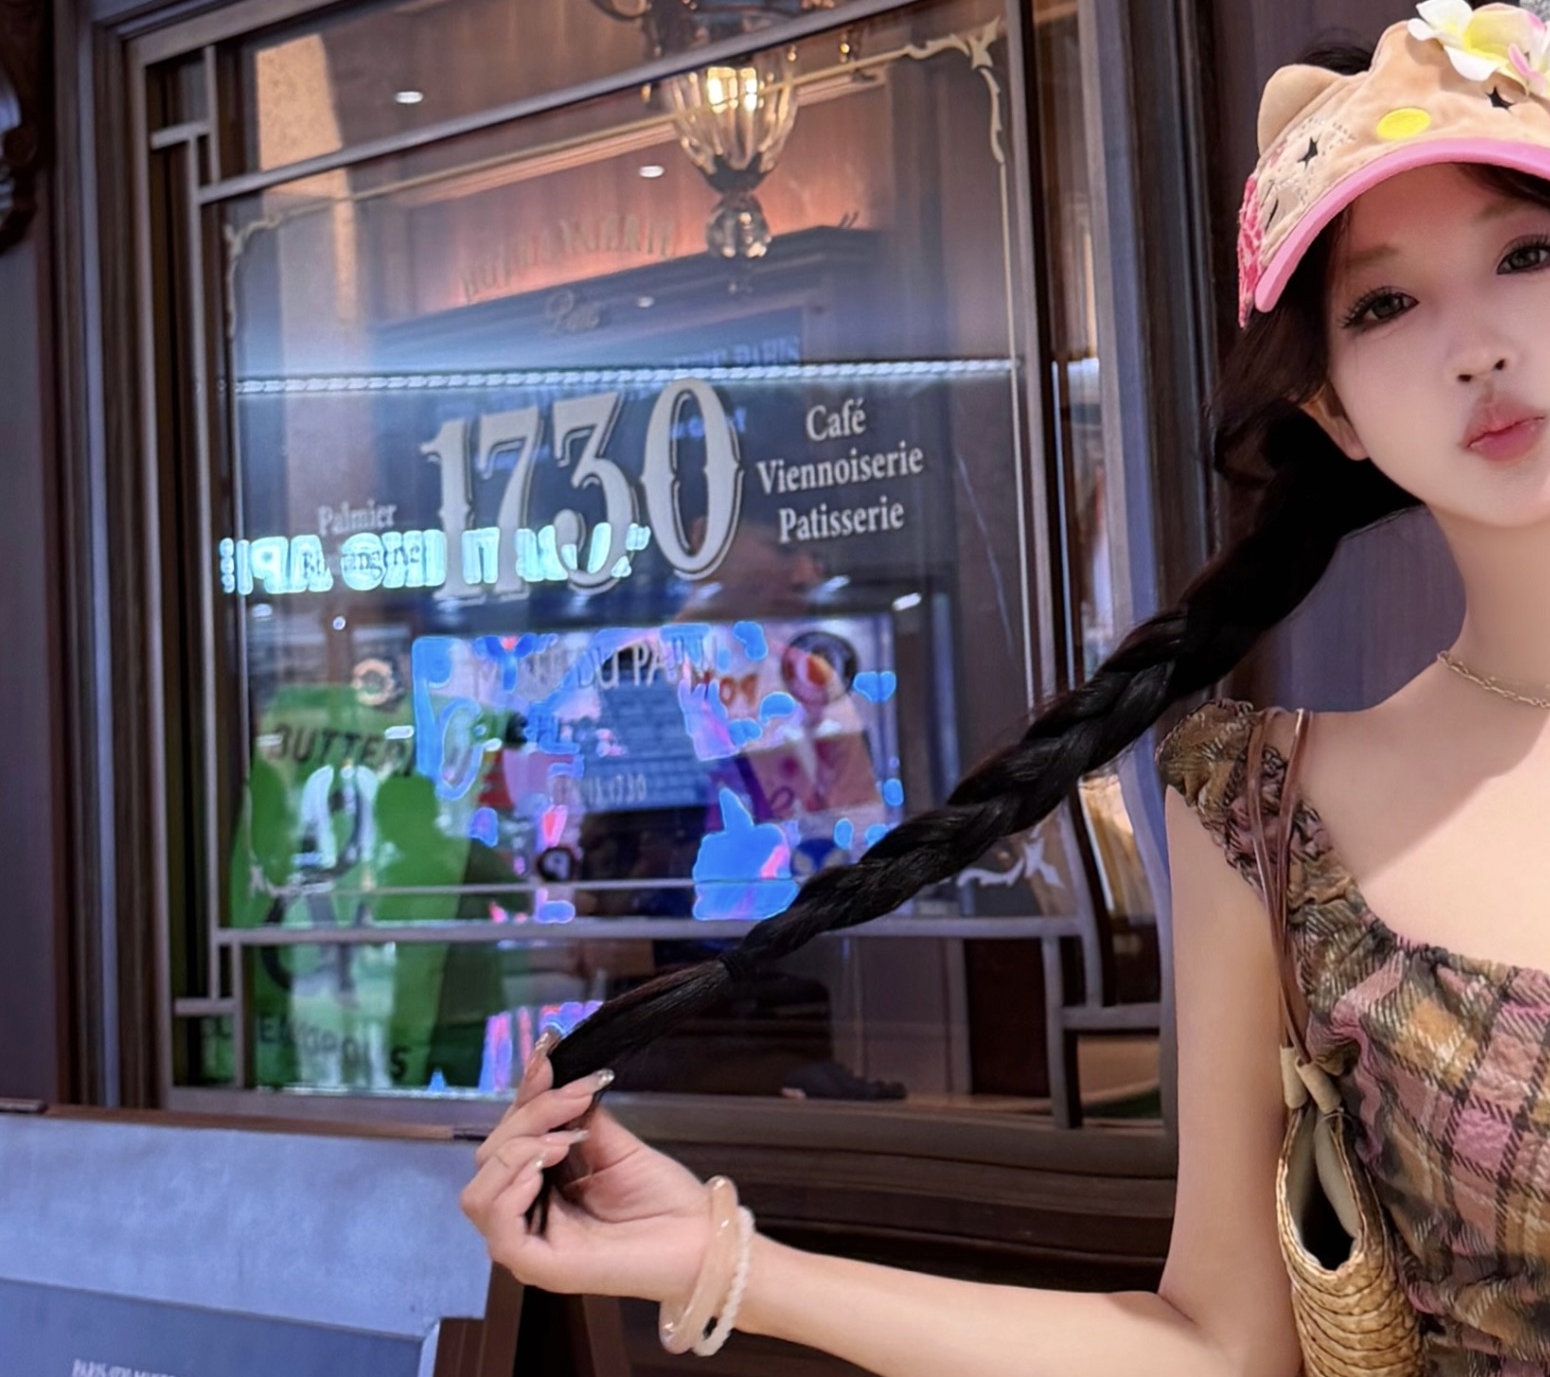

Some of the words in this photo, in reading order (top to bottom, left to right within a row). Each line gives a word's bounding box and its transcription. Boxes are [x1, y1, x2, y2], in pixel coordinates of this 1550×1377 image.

[805, 398, 867, 442] Café
[420, 377, 743, 606] 1730
[755, 439, 924, 495] Viennoiserie
[317, 499, 398, 536] Palmier
[778, 494, 905, 544] Patisserie
